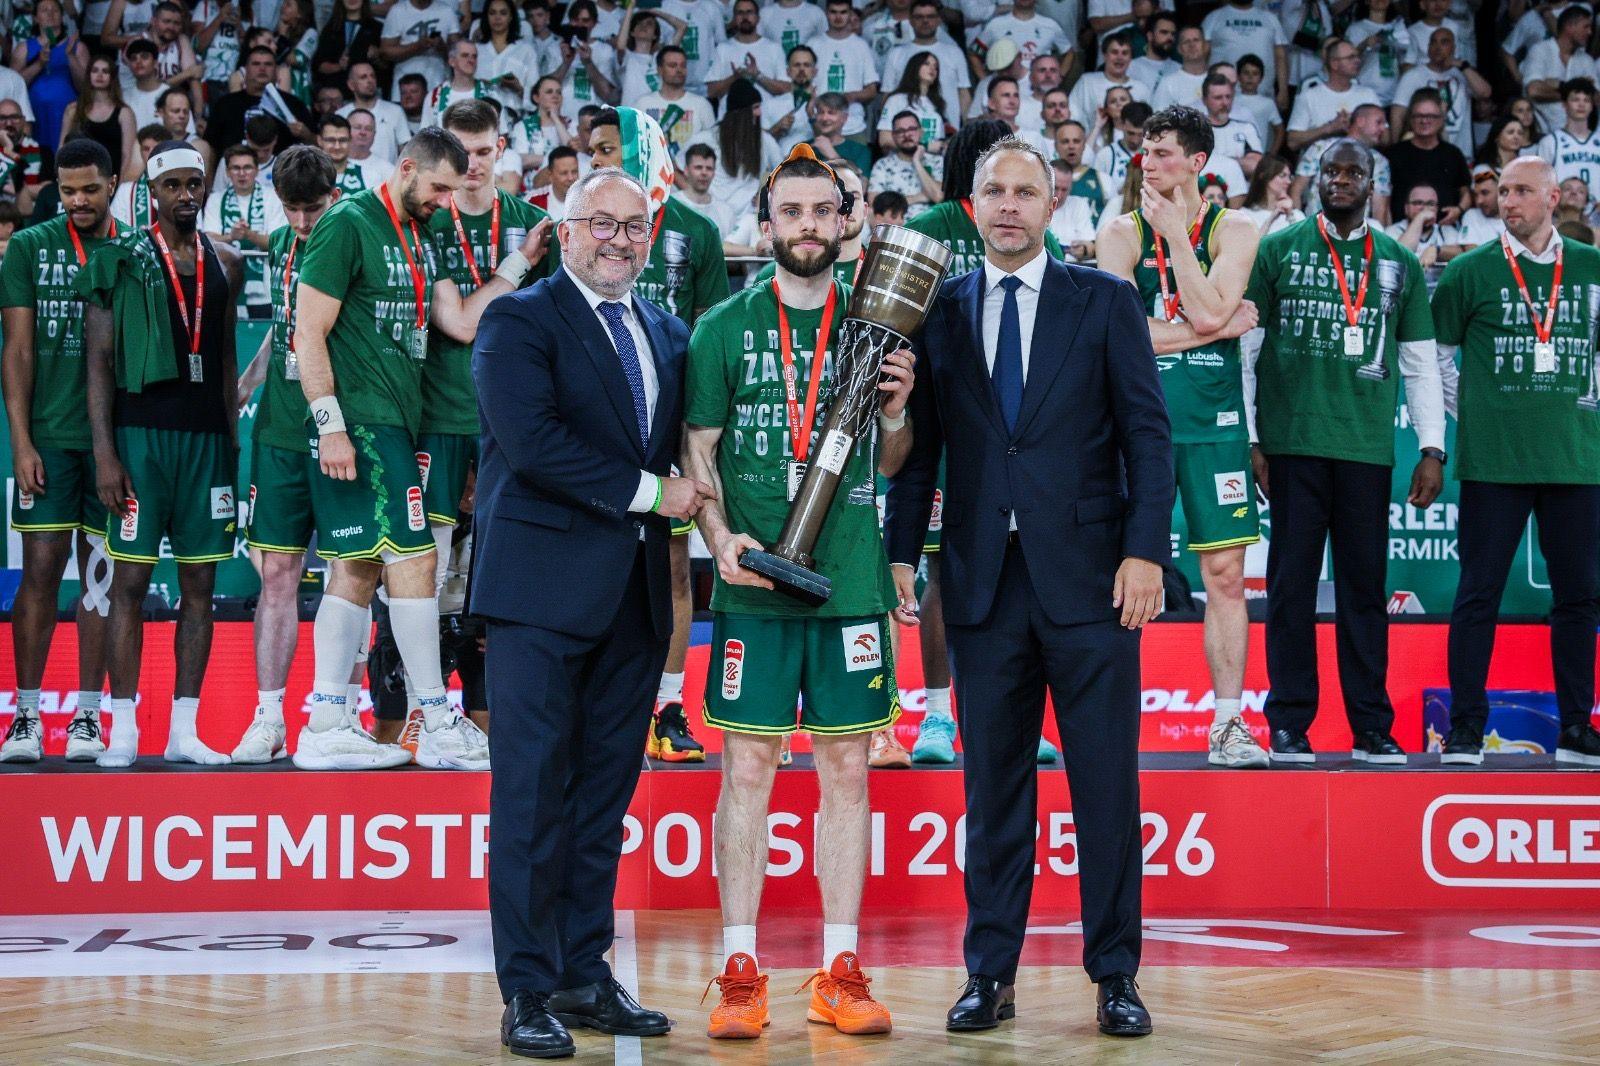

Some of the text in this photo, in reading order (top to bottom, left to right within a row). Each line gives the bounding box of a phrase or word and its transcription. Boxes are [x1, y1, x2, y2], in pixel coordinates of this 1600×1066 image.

[1280, 318, 1374, 346] POLSI
[1494, 354, 1587, 377] POSKI
[852, 652, 880, 664] ORLEN
[1448, 817, 1600, 864] ORLE
